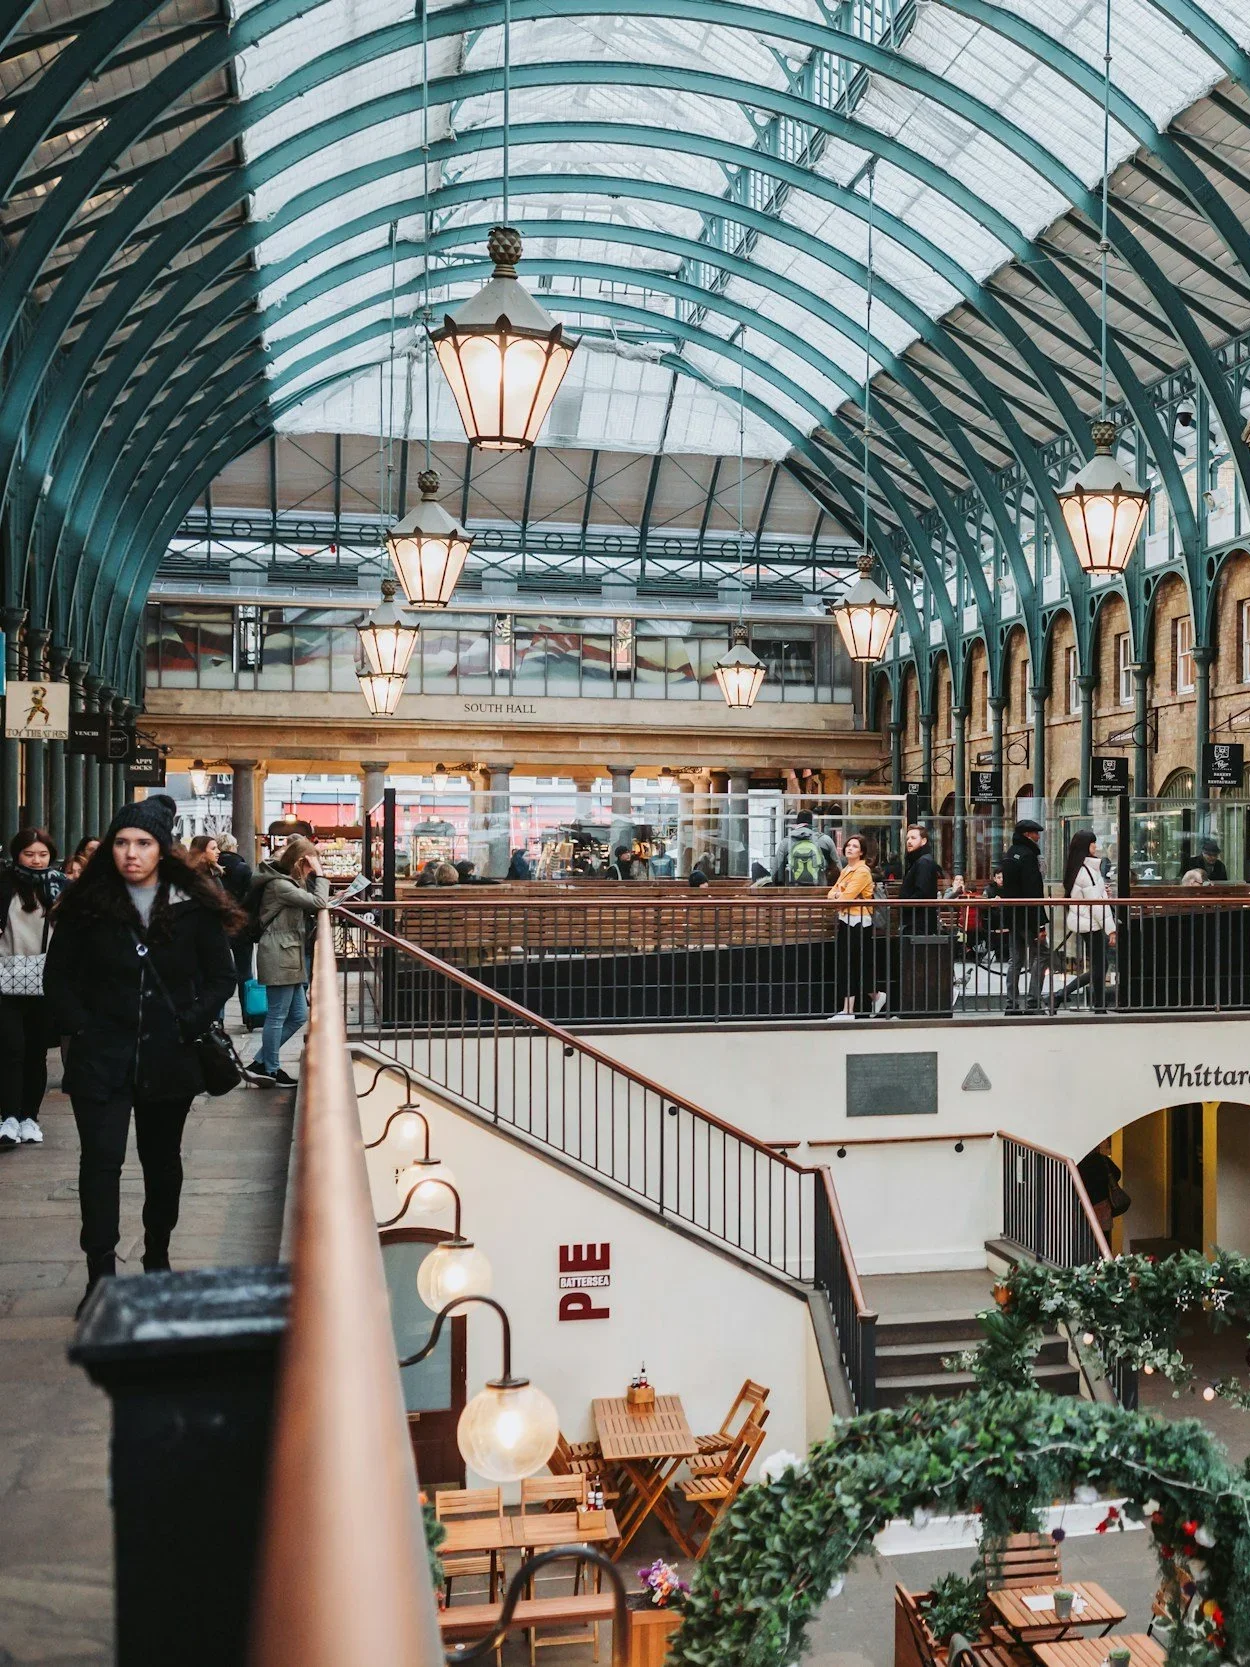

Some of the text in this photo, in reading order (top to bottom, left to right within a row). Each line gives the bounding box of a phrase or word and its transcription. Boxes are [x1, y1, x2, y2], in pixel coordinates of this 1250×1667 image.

[463, 703, 537, 714] SOUTH HALL
[6, 728, 68, 739] TOY THEATRES
[560, 1276, 610, 1288] BATTERSEA
